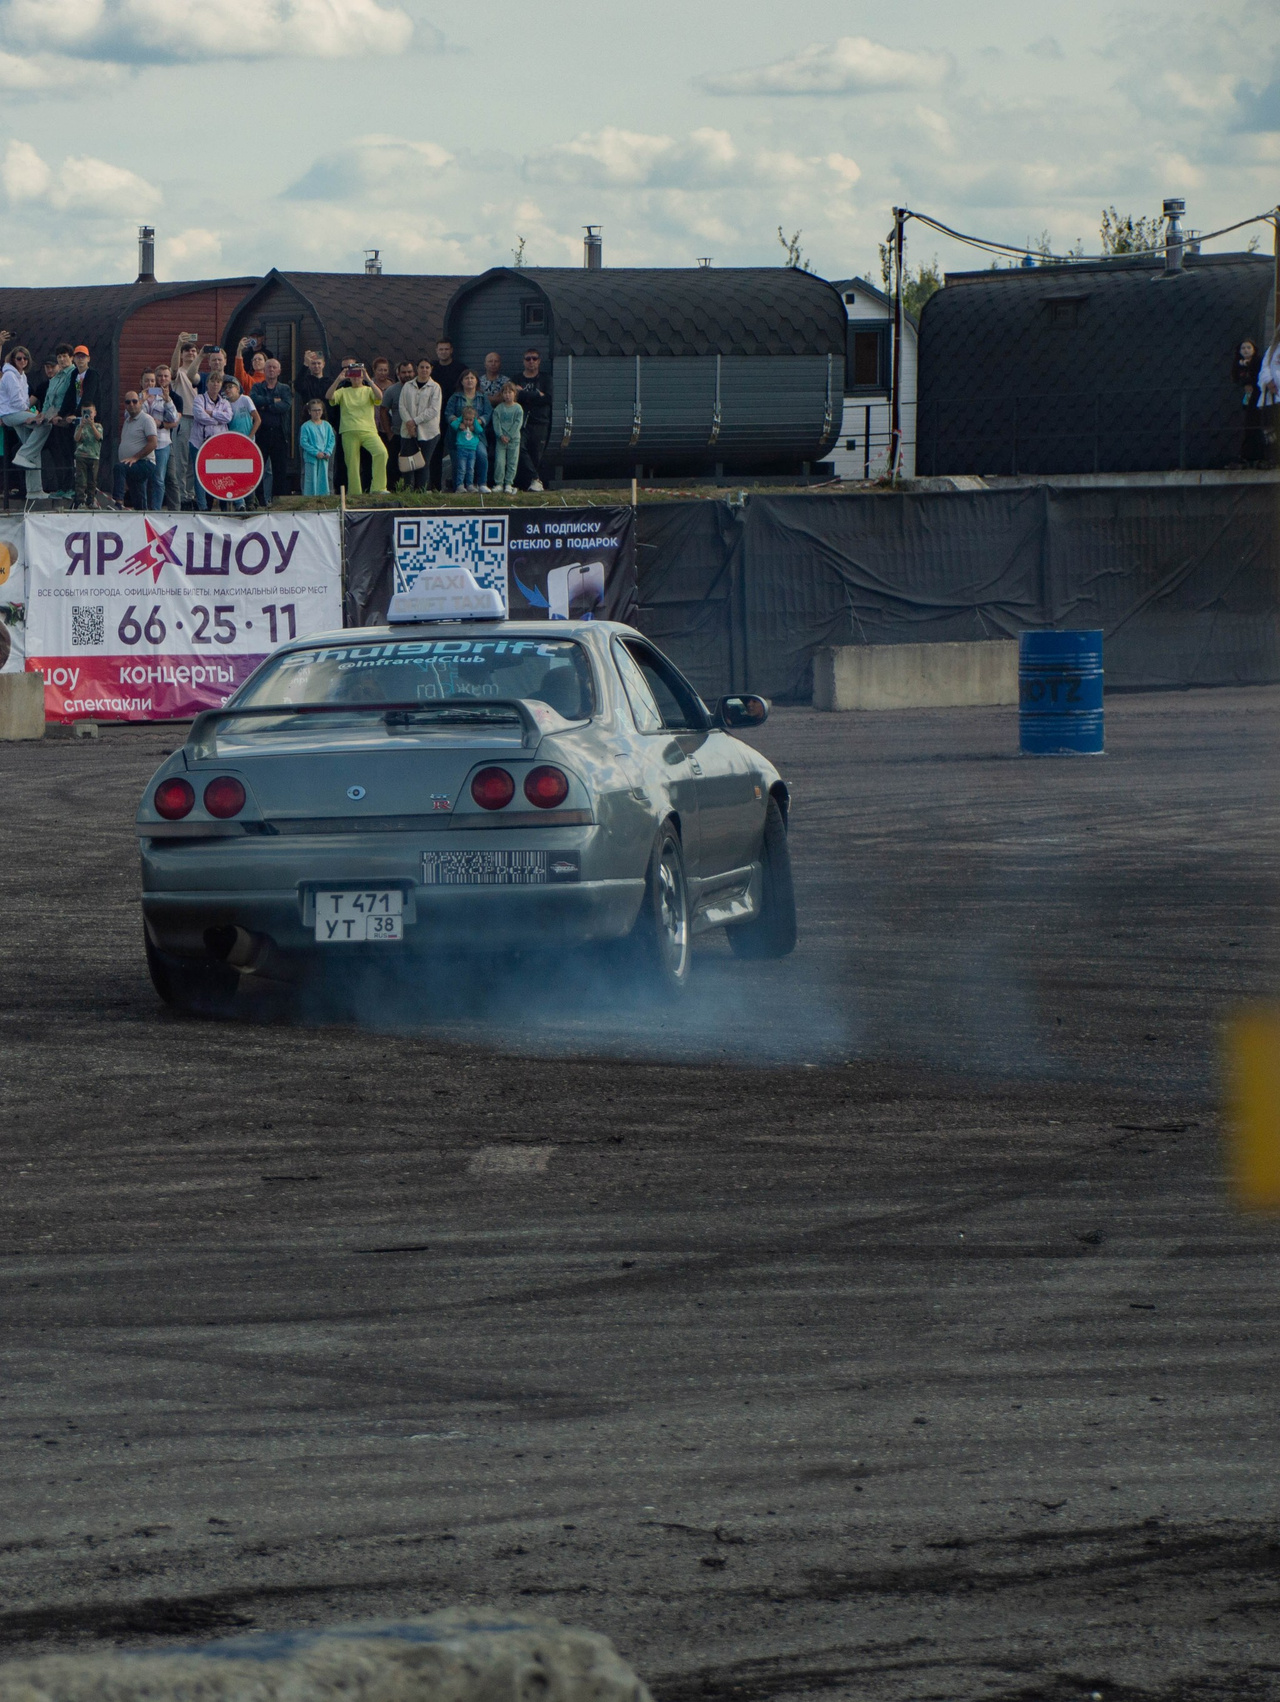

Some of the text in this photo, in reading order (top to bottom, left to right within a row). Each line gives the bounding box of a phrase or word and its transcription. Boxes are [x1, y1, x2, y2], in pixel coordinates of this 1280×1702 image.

[526, 522, 601, 536] ЗА ПОДПИСКУ
[509, 536, 618, 550] СТЕКЛО В ПОДАРОК
[64, 530, 300, 576] ЯР ШОУ
[37, 588, 52, 597] ВСЕ
[53, 588, 89, 597] СОБЫТИЯ
[125, 587, 182, 597] ОФИЦИАЛЬНЫЕ
[213, 585, 278, 596] МАКСИМАЛЬНЫЙ
[279, 586, 306, 595] ВЫБОР
[307, 585, 327, 594] МЕСТ
[421, 575, 465, 591] TAXI
[394, 594, 491, 612] DRIFT TAXI
[338, 655, 485, 671] @InfraredClub
[120, 664, 235, 689] концерты
[64, 697, 153, 713] спектакли
[443, 865, 546, 875] СКОРОСТЬ
[330, 893, 390, 914] Т 471
[325, 917, 394, 939] УТ 38
